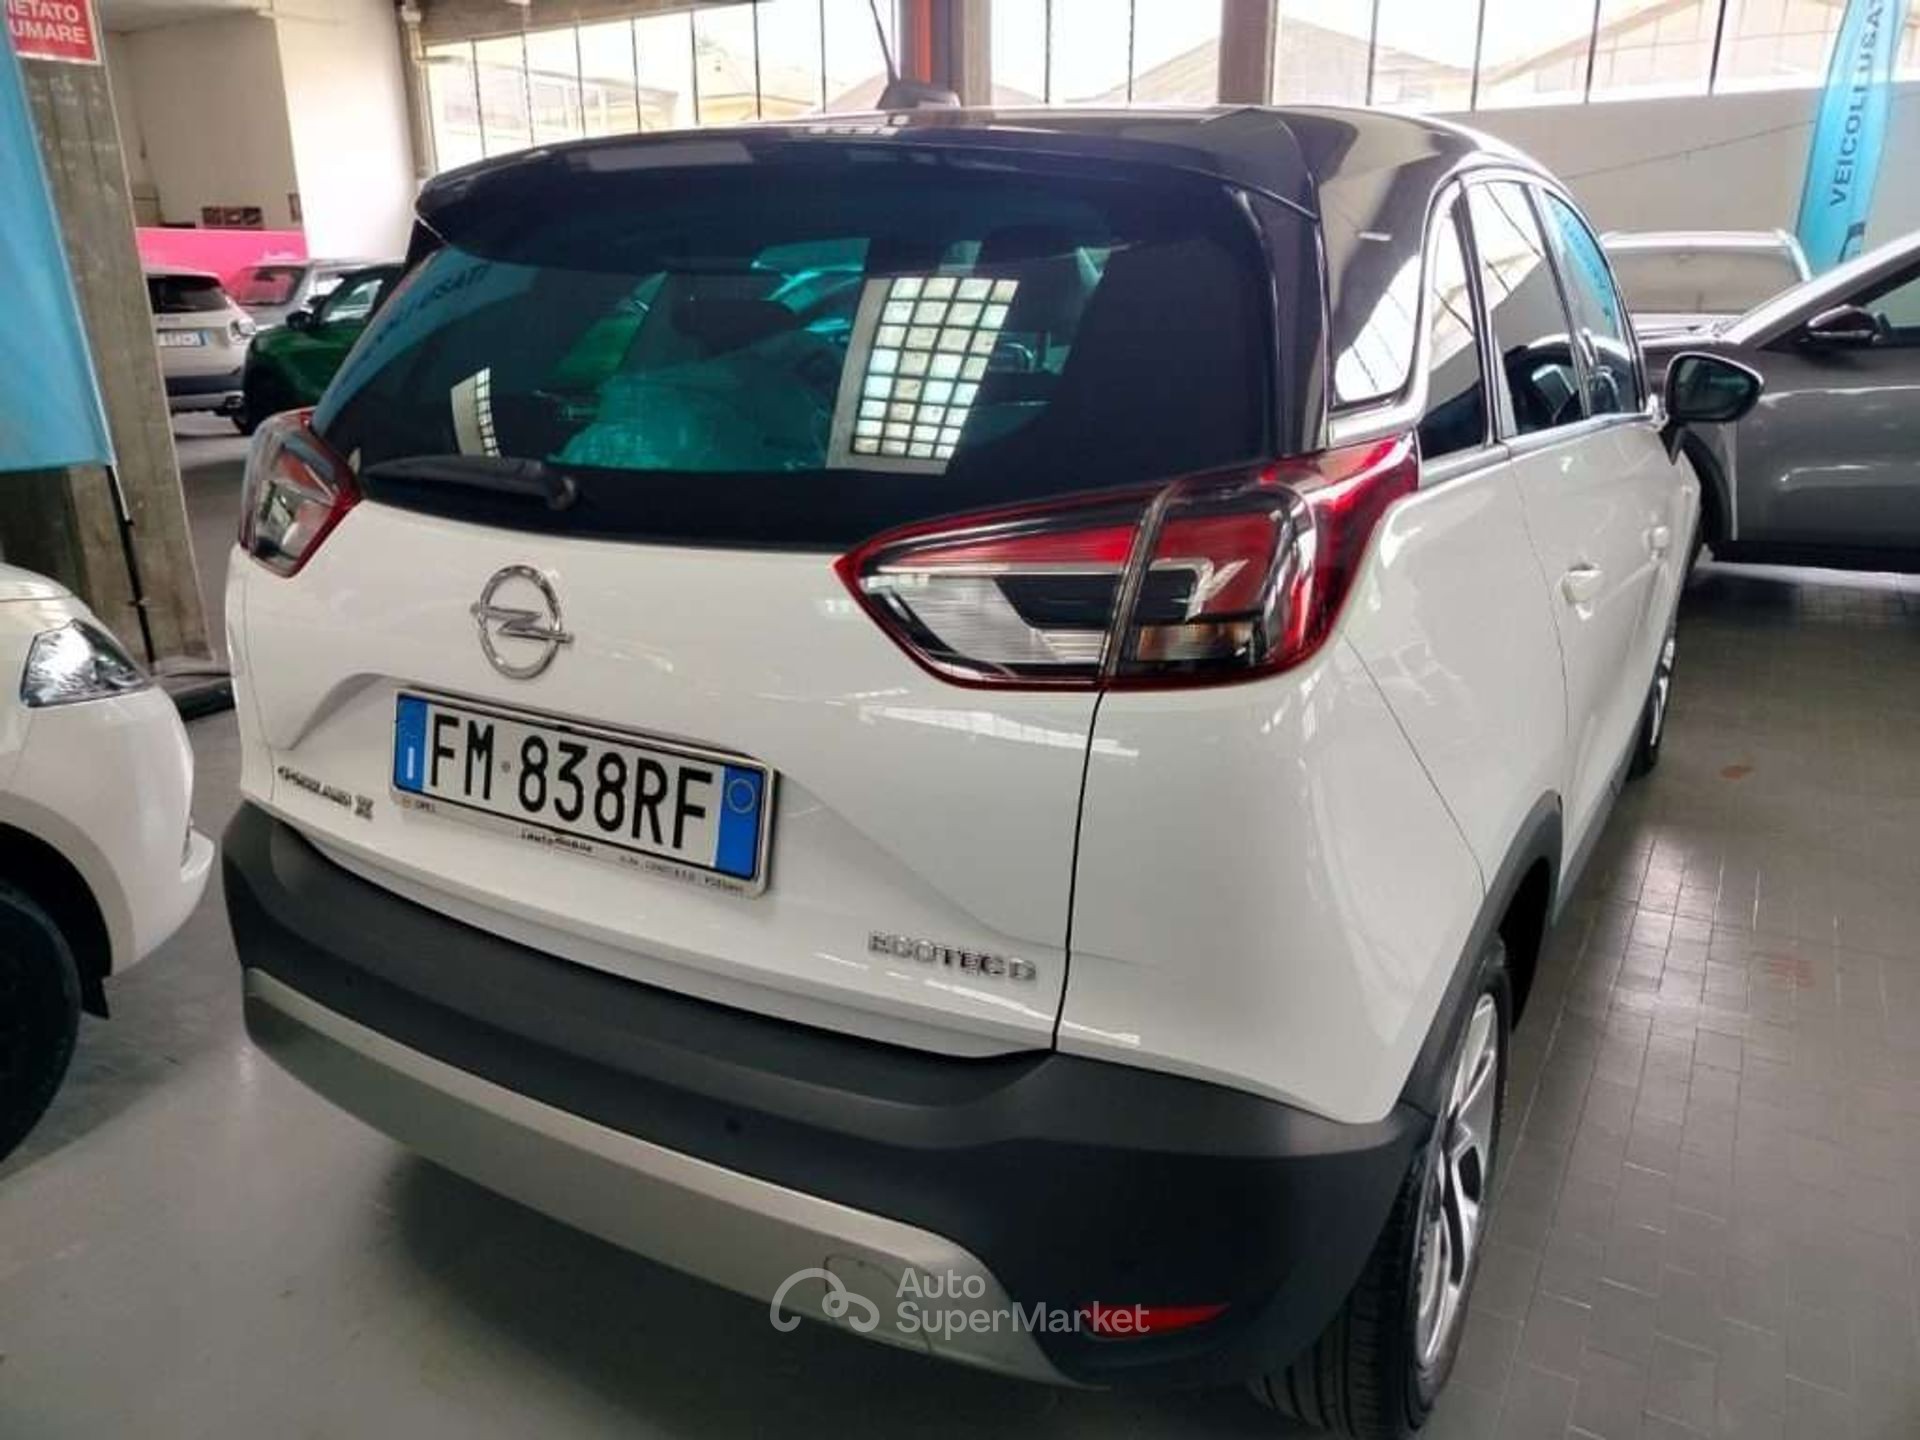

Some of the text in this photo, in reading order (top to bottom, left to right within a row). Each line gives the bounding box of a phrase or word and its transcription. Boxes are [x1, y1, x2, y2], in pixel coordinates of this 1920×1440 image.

[8, 0, 79, 22] IETATO
[9, 19, 87, 44] UMARE
[1830, 85, 1868, 207] VEICOLI
[431, 713, 714, 849] FM 838RF
